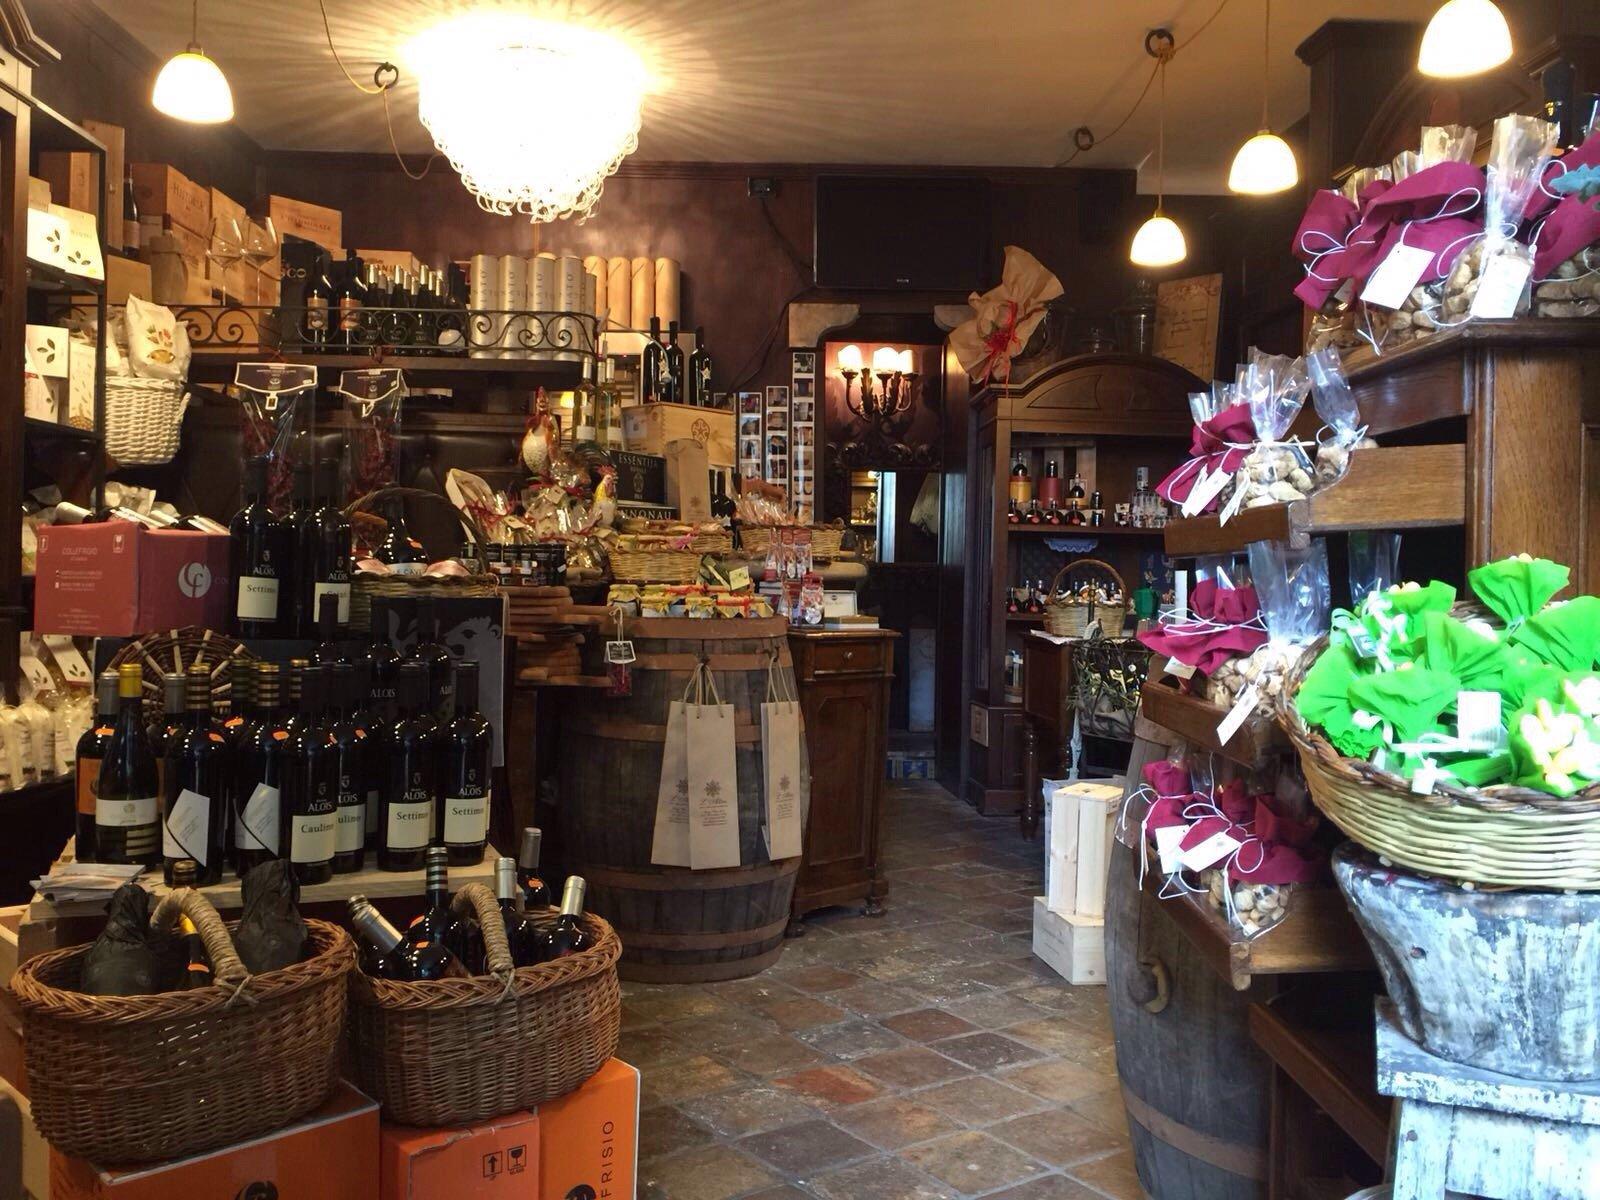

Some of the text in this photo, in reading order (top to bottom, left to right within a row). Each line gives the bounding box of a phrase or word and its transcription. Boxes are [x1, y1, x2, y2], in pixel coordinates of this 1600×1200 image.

[402, 790, 427, 801] ALOIS
[458, 787, 482, 797] ALOIS
[337, 793, 359, 804] LOIS
[308, 802, 333, 812] ALOIS
